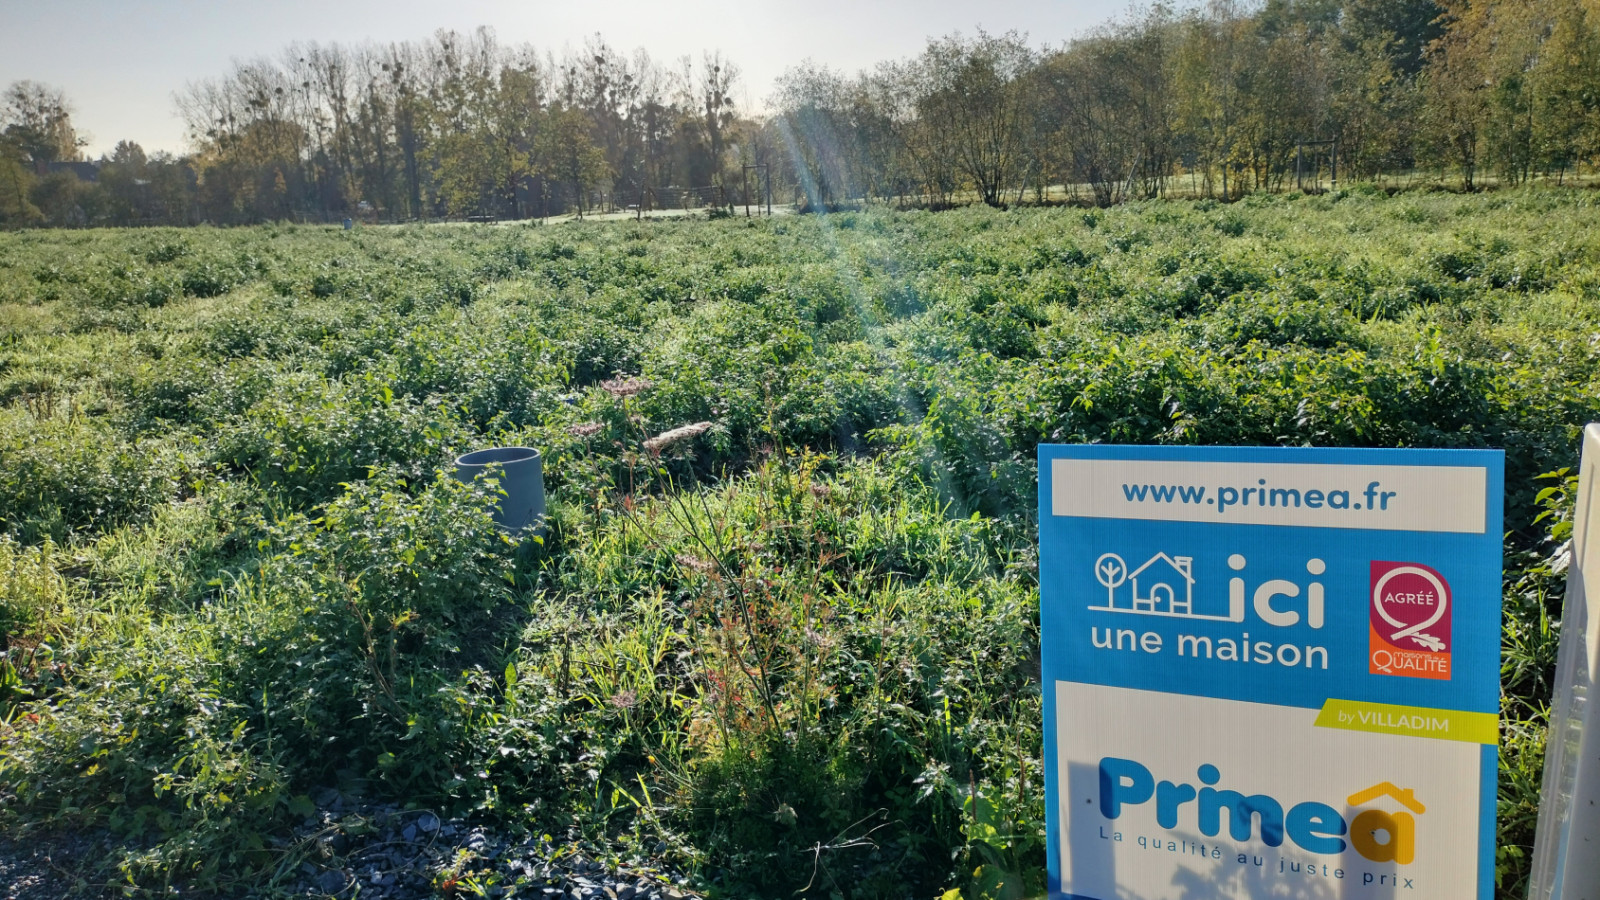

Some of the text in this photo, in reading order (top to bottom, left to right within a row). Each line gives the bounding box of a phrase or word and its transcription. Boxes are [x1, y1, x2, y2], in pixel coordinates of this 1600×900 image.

[1122, 479, 1397, 514] www.primea.fr
[1227, 553, 1326, 629] ici
[1384, 590, 1434, 605] AGRÉÉ
[1091, 625, 1328, 670] une maison
[1372, 650, 1447, 673] QUALITÉ
[1338, 709, 1450, 732] by VILLADIM
[1100, 825, 1414, 889] La qualité au juste prix
